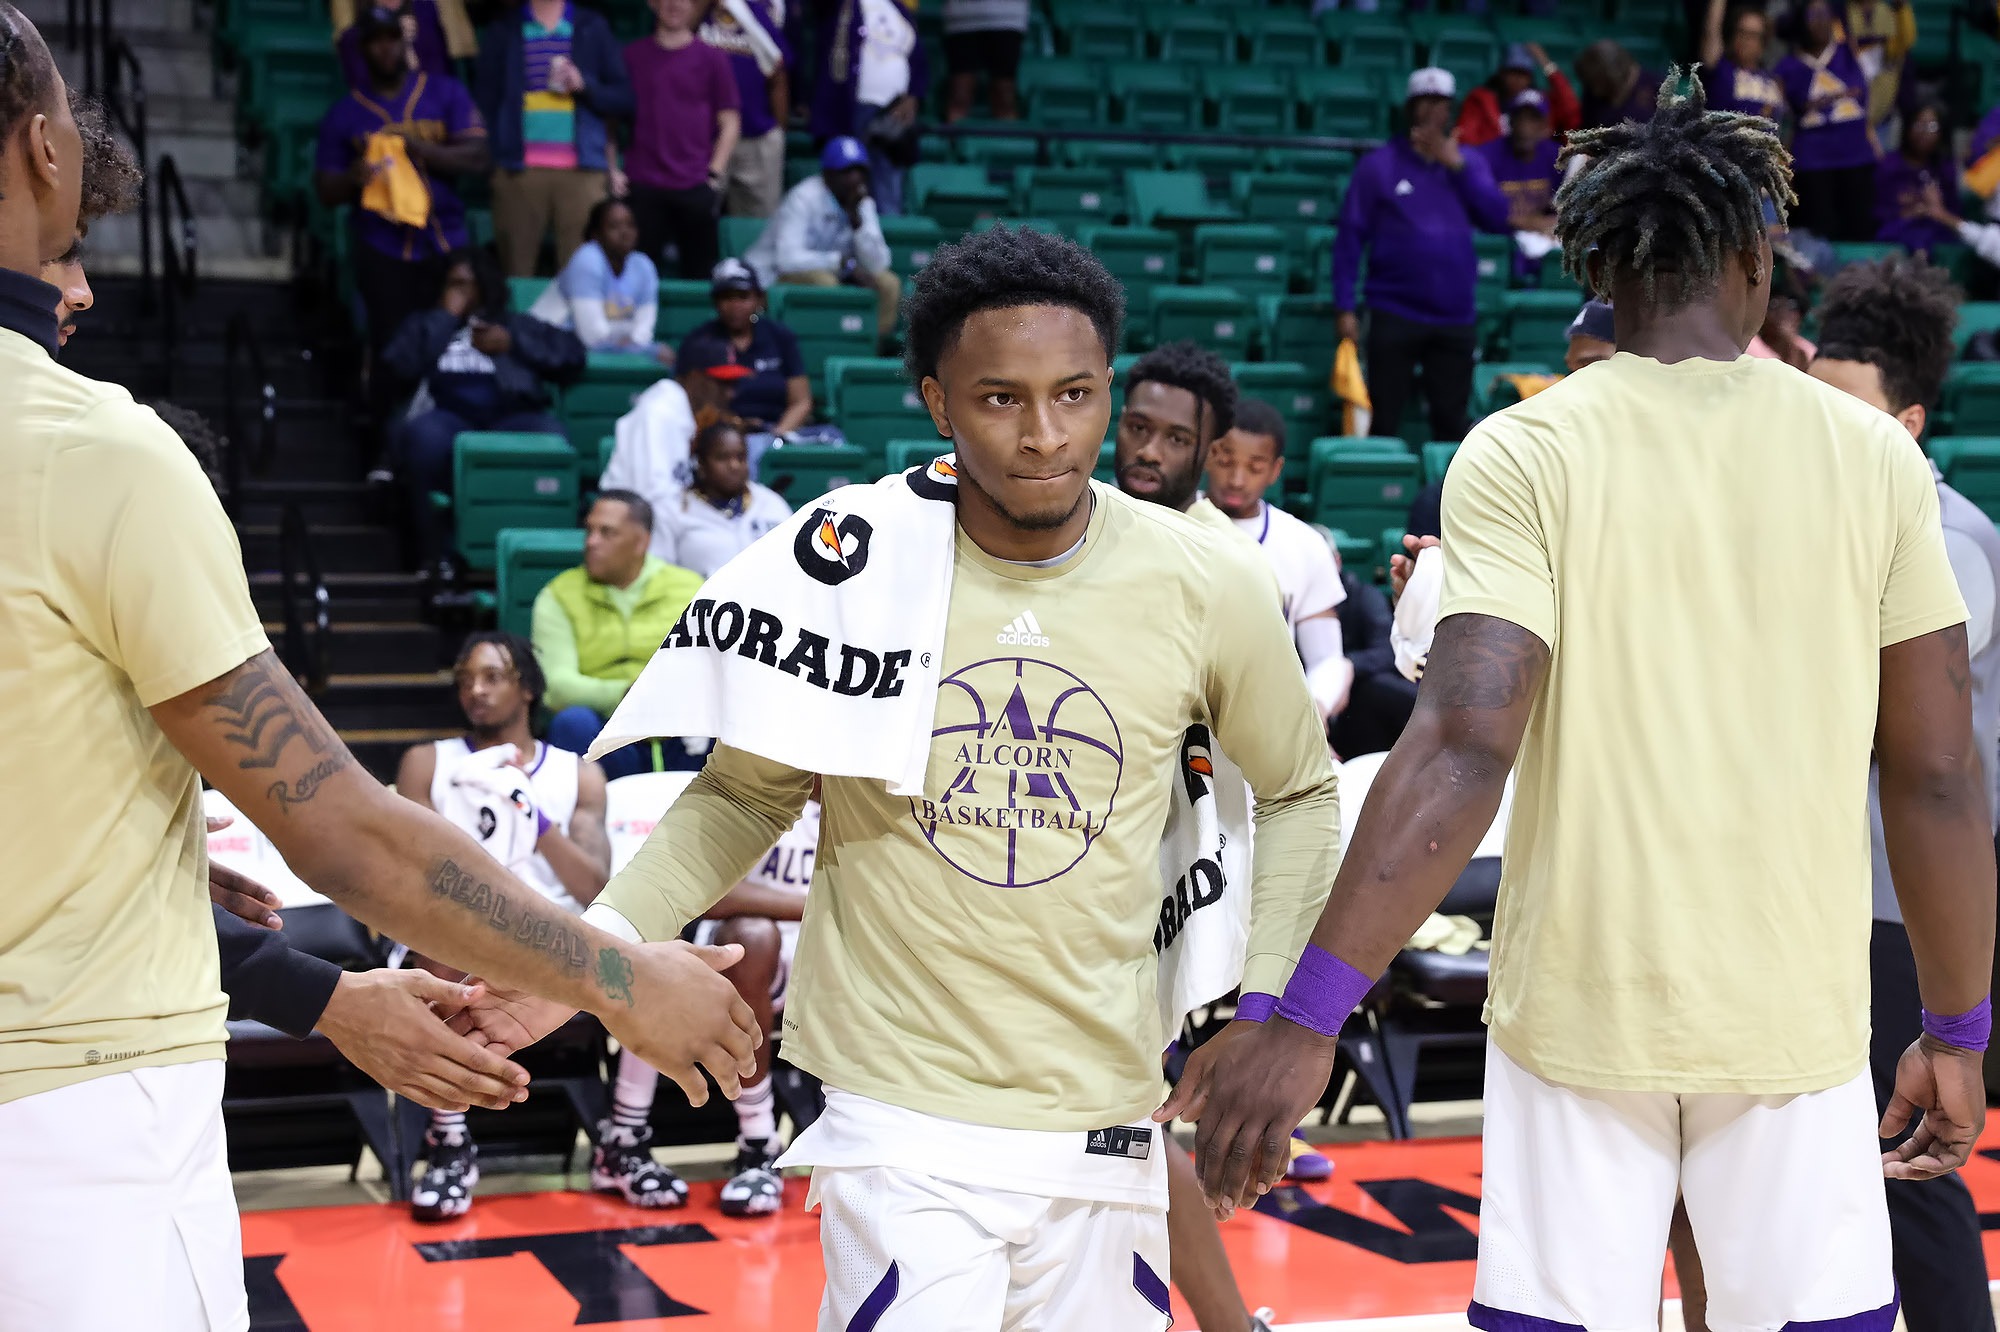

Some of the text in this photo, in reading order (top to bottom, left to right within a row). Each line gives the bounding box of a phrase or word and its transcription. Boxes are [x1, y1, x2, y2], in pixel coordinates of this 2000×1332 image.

[996, 631, 1051, 648] adidas
[954, 742, 1073, 769] ALCORN
[922, 800, 1100, 831] BASKETBALL
[432, 859, 587, 967] REAL DEAL
[1153, 850, 1228, 957] RAD
